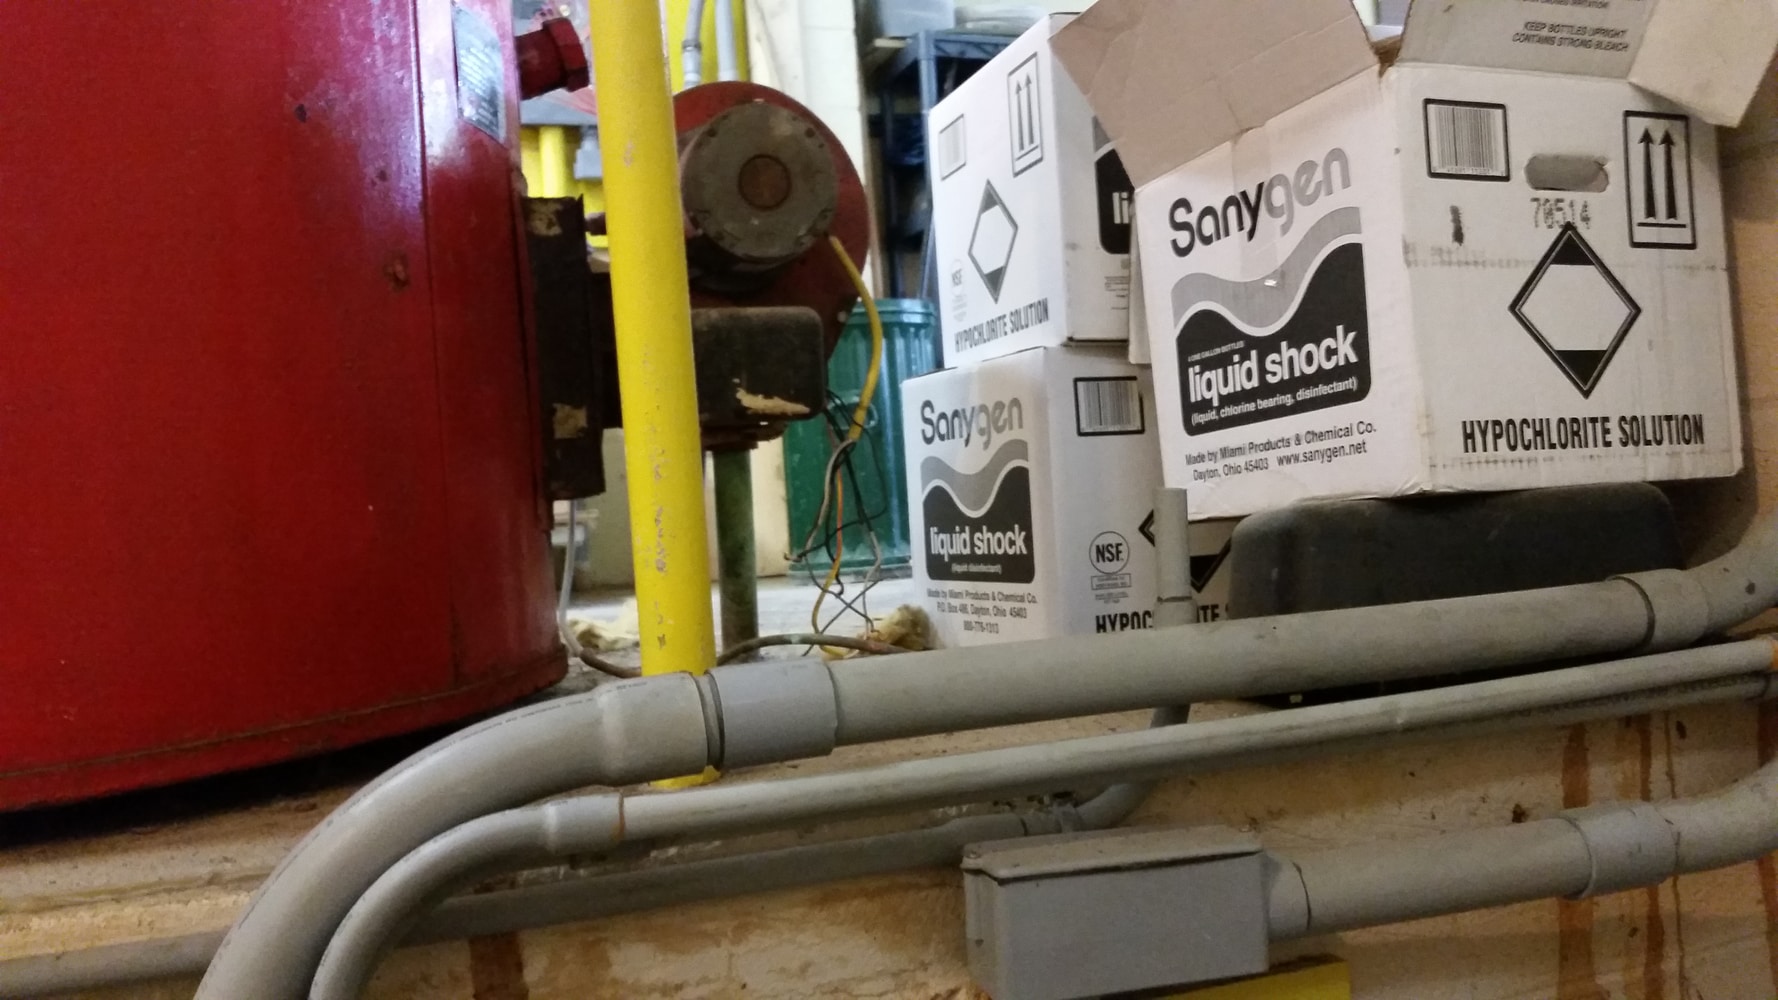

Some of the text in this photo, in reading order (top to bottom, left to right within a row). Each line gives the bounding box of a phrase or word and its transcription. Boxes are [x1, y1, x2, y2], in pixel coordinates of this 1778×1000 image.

[1512, 33, 1629, 52] CONTAINS STRONG BLEACH
[1524, 21, 1629, 39] KEEP BOTTLES UPRIGHT
[1168, 147, 1352, 258] Sanygen
[1009, 297, 1050, 334] SOLUTION
[1188, 325, 1359, 407] liquid shock
[1191, 376, 1358, 426] (liquid, chlorine bearing, disinfectant)
[920, 397, 1024, 452] Sanygen
[1185, 420, 1377, 466] Made by Miami Products & Chemical Co.
[1461, 414, 1705, 453] HYPOCHLORITE SOLUTION
[1192, 439, 1368, 482] Dayton, Ohio 45403 www.sanygen.net
[930, 524, 1028, 562] liquid shock
[1095, 542, 1123, 563] NSF
